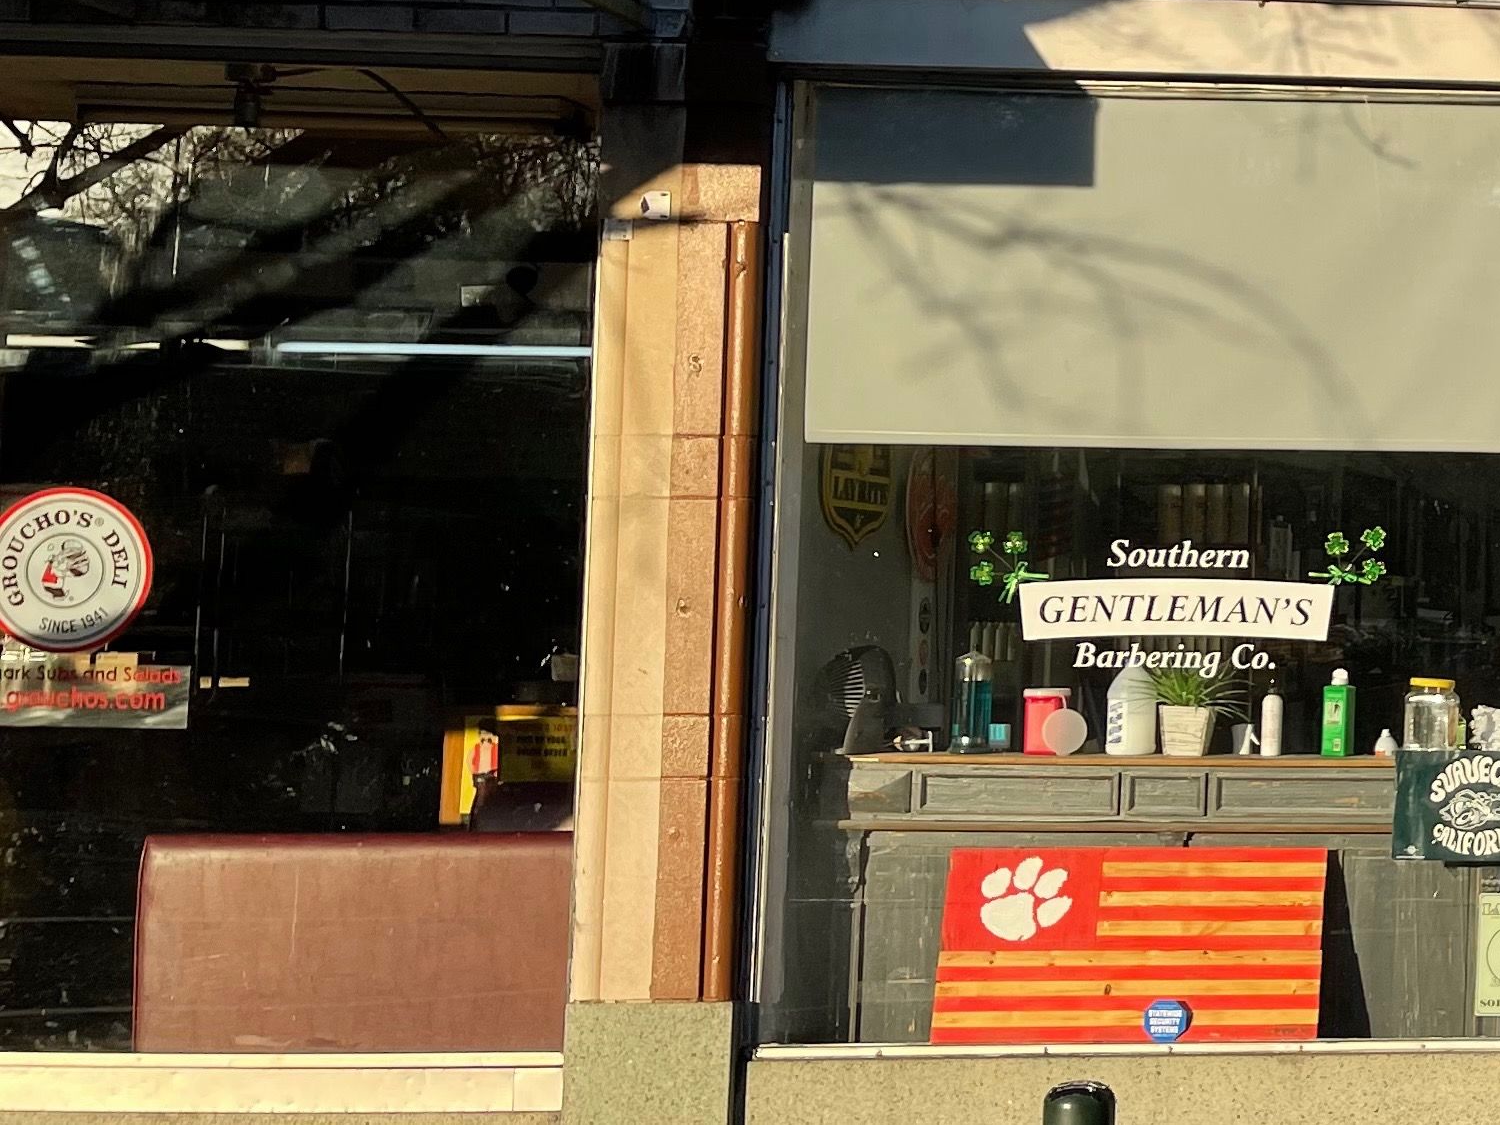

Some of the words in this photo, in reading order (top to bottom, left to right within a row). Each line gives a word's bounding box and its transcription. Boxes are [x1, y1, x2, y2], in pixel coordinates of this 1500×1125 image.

[2, 509, 94, 607] GROUCHO'S
[102, 529, 130, 589] DELI
[1106, 539, 1250, 570] Southern
[38, 617, 78, 634] SINCE
[80, 607, 109, 629] 1941
[1038, 593, 1314, 627] GENTLEMAN'S
[0, 666, 31, 681] ark
[83, 667, 117, 682] and
[1073, 641, 1222, 678] Barbering
[1231, 643, 1277, 671] Co.
